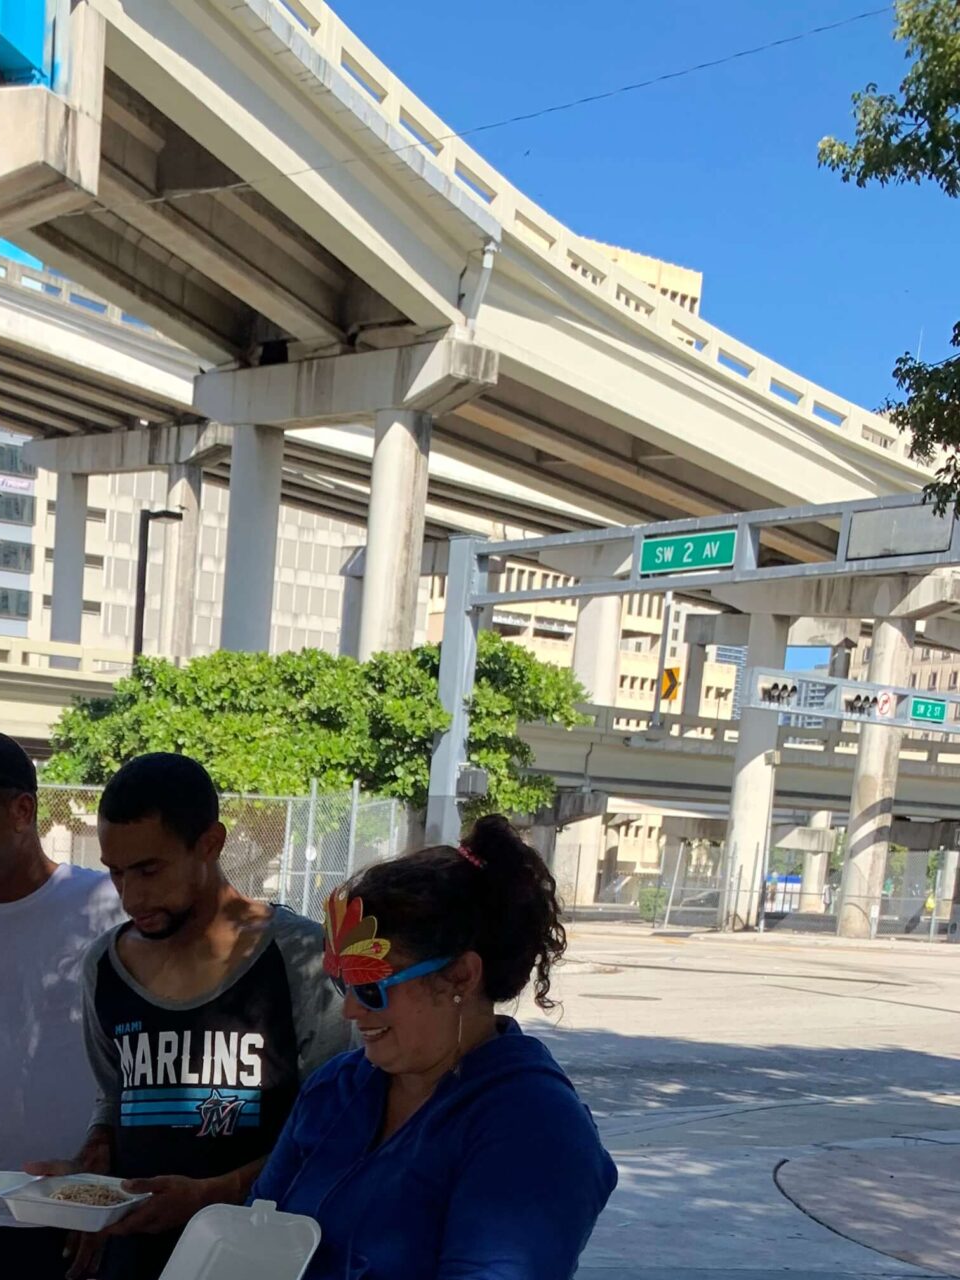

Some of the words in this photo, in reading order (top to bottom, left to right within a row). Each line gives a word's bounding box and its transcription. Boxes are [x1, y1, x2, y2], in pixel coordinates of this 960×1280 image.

[655, 545, 674, 564] SW
[683, 541, 694, 563] 2
[702, 541, 720, 559] AV
[916, 704, 925, 714] SW
[926, 704, 932, 717] 2
[933, 706, 941, 717] ST
[115, 1021, 142, 1035] MIAMI
[113, 1030, 265, 1088] MARLINS
